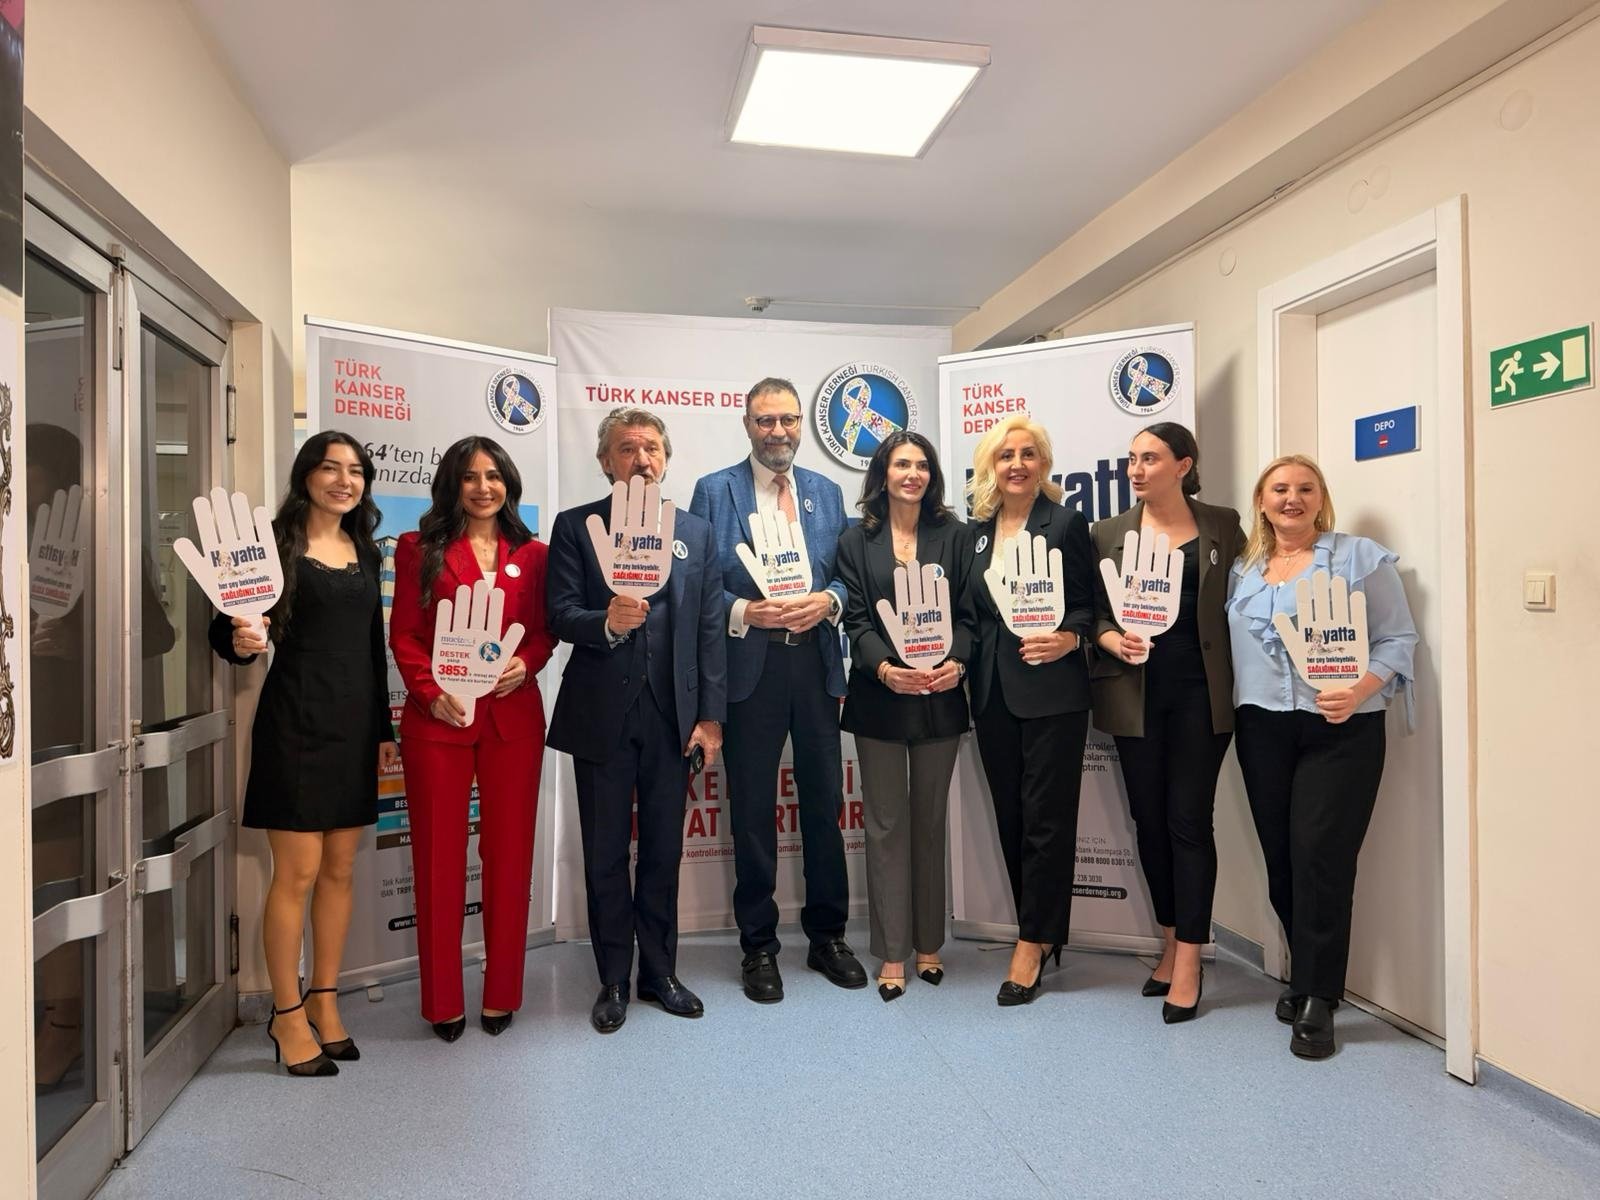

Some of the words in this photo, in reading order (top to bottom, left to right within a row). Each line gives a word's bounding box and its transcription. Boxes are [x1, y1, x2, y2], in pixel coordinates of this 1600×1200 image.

[335, 358, 382, 380] TÜRK
[824, 364, 858, 397] DERNEĞİ
[335, 379, 405, 402] KANSER
[586, 384, 636, 404] TÜRK
[641, 389, 715, 407] KANSER
[720, 392, 751, 409] DE
[861, 364, 899, 383] TURKISH
[898, 380, 918, 418] CANCER
[908, 419, 918, 432] SO
[962, 383, 1004, 400] TÜRK
[335, 399, 411, 421] DERNEĞİ
[818, 396, 830, 436] KANSER
[963, 397, 1026, 417] KANSER
[1375, 420, 1395, 432] DEPO
[824, 436, 846, 458] TÜRK
[860, 459, 870, 467] 19
[220, 587, 256, 600] SAĞLIĞINIZ
[256, 584, 274, 594] ASLA!
[440, 650, 470, 658] DESTEK
[438, 664, 468, 676] 3853
[1307, 665, 1339, 673] SAĞLIĞINIZ
[395, 800, 408, 808] BES
[400, 835, 411, 844] MA
